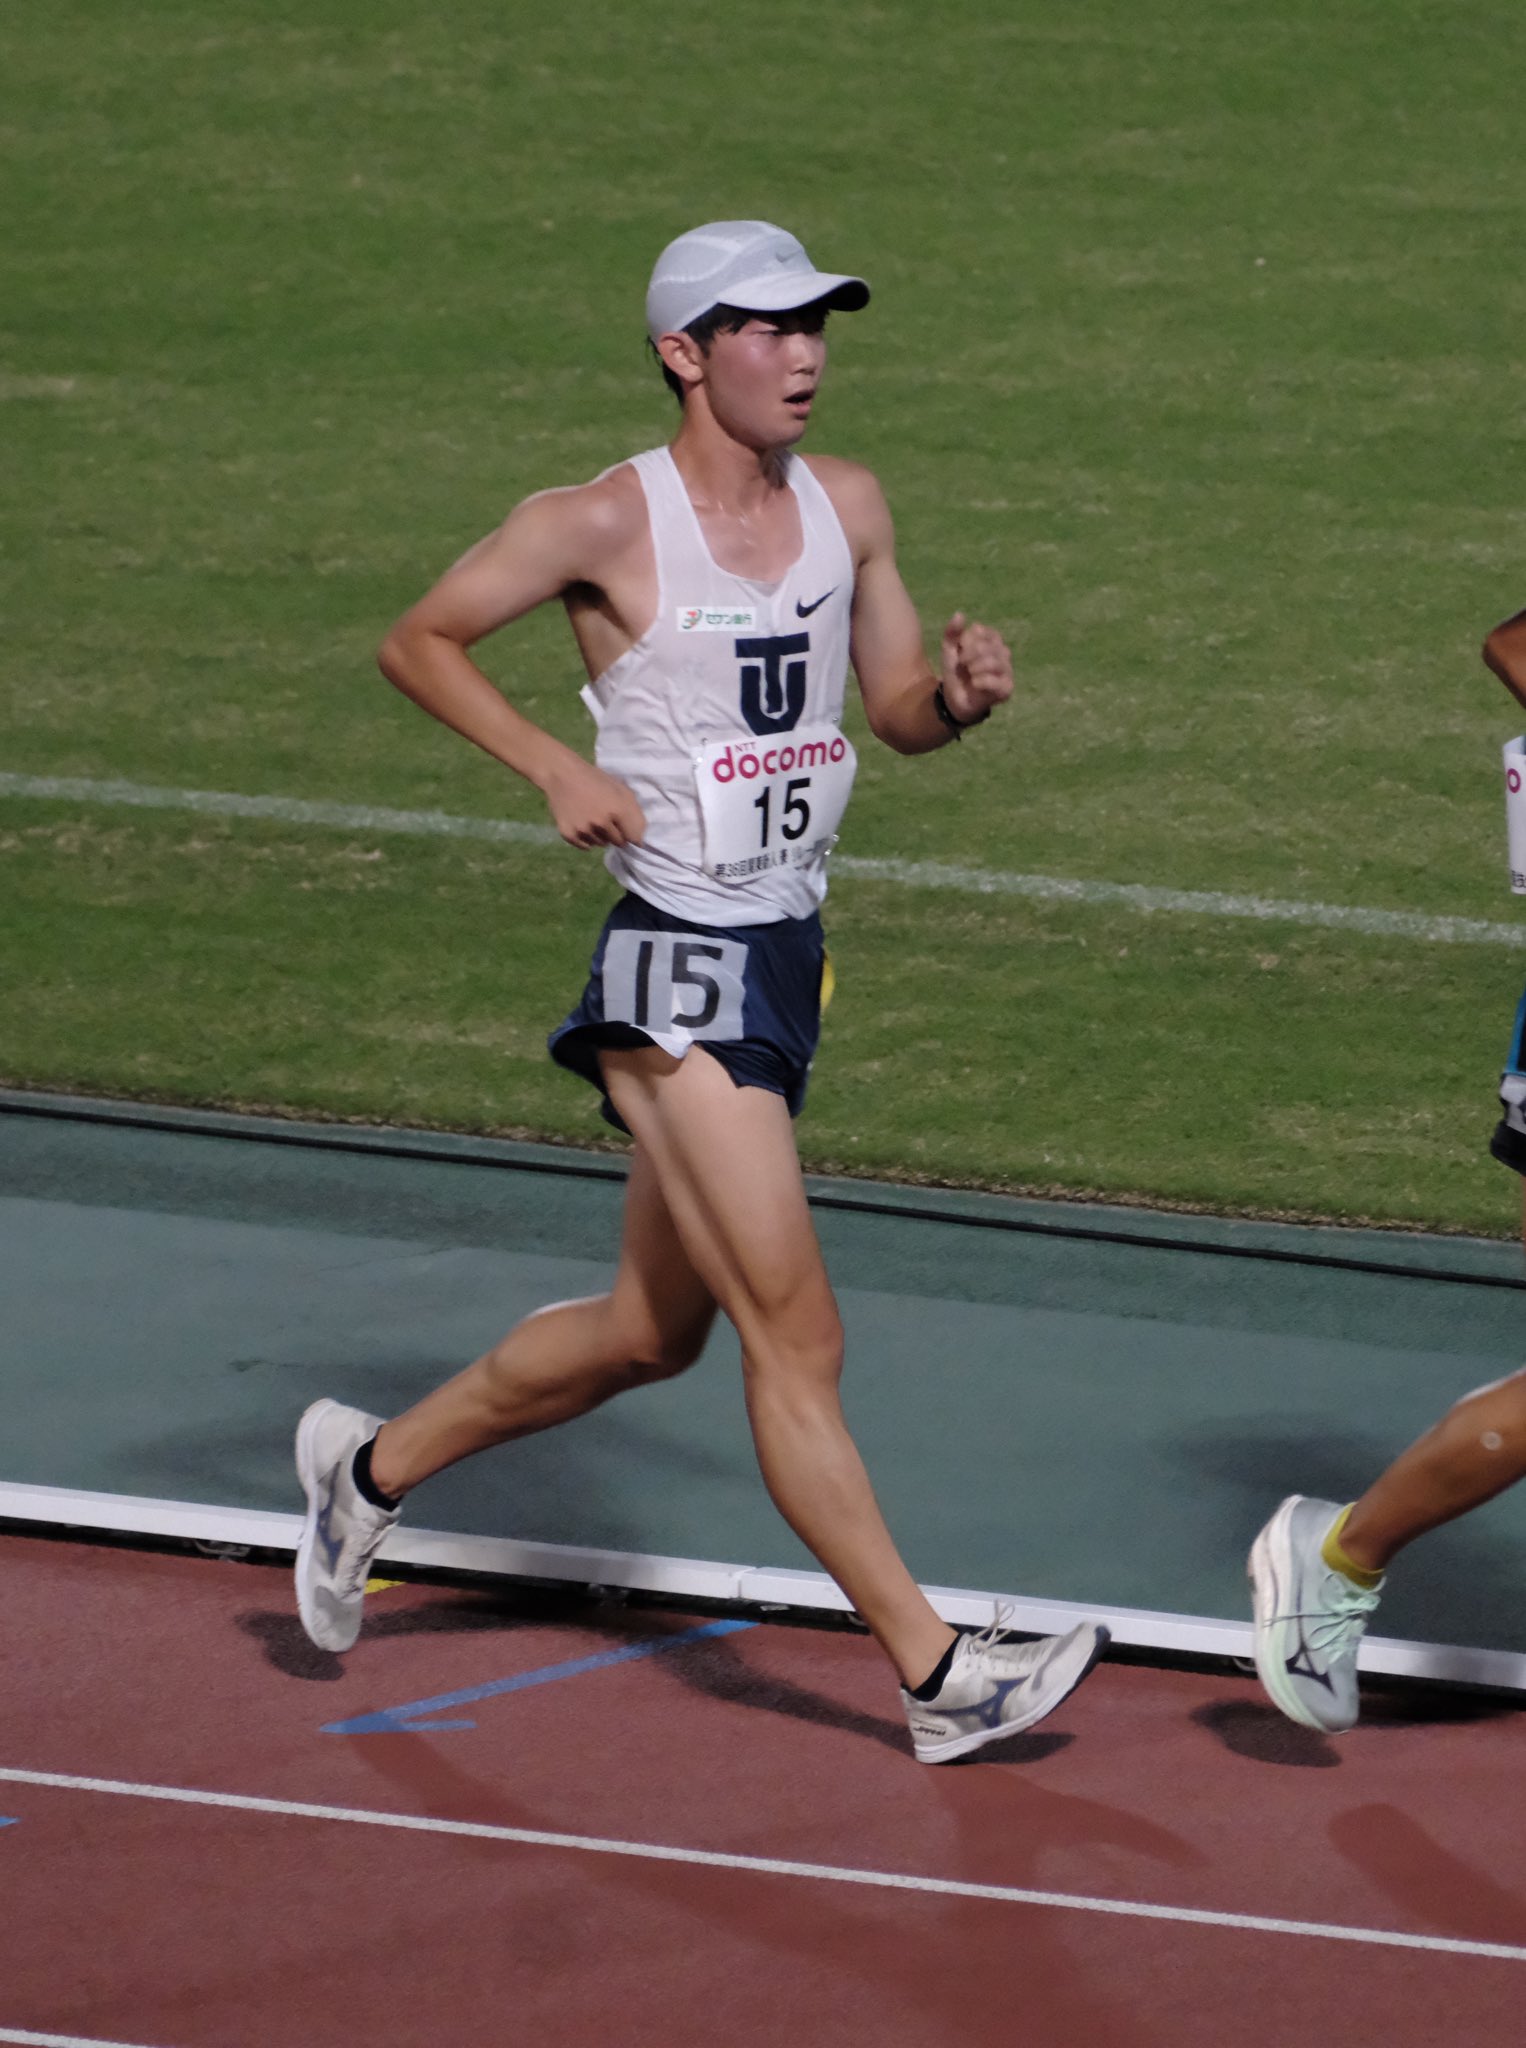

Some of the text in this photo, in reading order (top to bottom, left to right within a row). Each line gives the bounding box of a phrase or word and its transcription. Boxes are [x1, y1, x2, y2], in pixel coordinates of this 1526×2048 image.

[712, 737, 846, 783] docomo
[754, 776, 812, 848] 15
[635, 940, 723, 1029] 15
